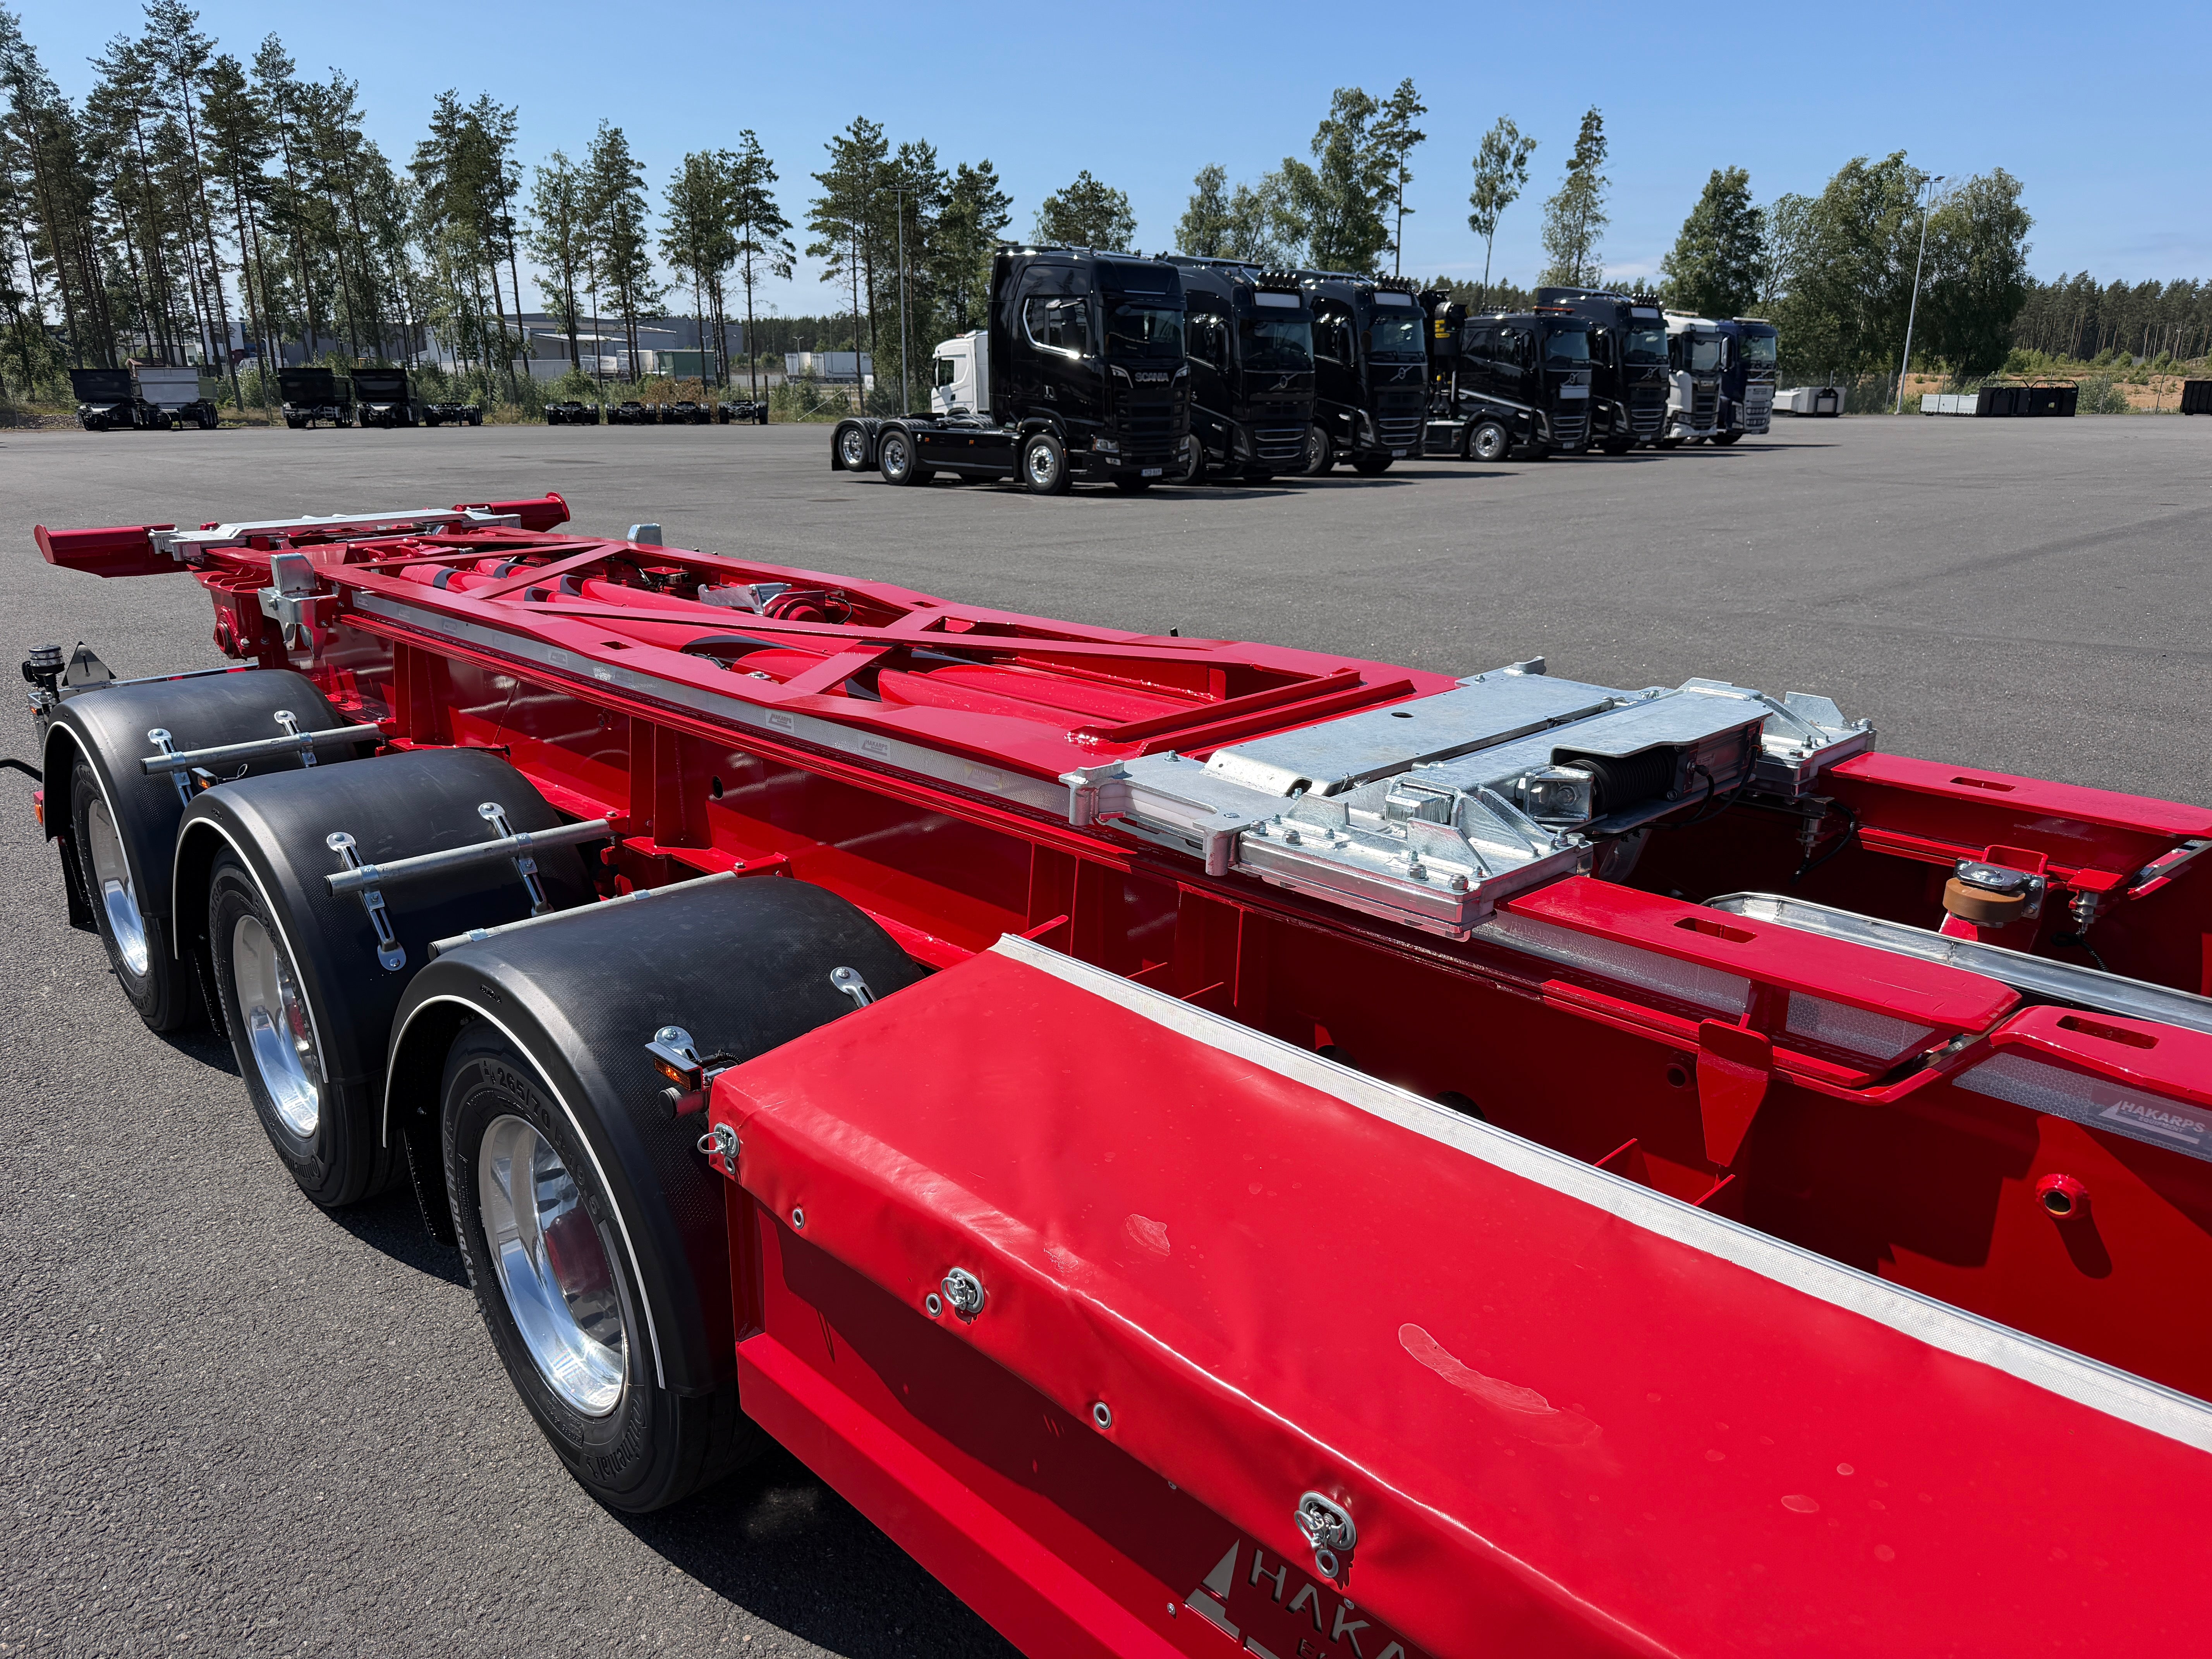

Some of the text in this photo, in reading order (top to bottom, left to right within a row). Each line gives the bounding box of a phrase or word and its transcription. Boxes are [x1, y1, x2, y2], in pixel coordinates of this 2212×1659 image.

[1135, 372, 1169, 382] SCANIA
[866, 739, 888, 750] HAKARPS
[497, 1067, 551, 1130] 265/70
[2121, 1101, 2206, 1133] HAKARPS
[2138, 1116, 2184, 1133] EQUIPMENT
[449, 1195, 478, 1287] Hybrid
[596, 1393, 647, 1482] Continental
